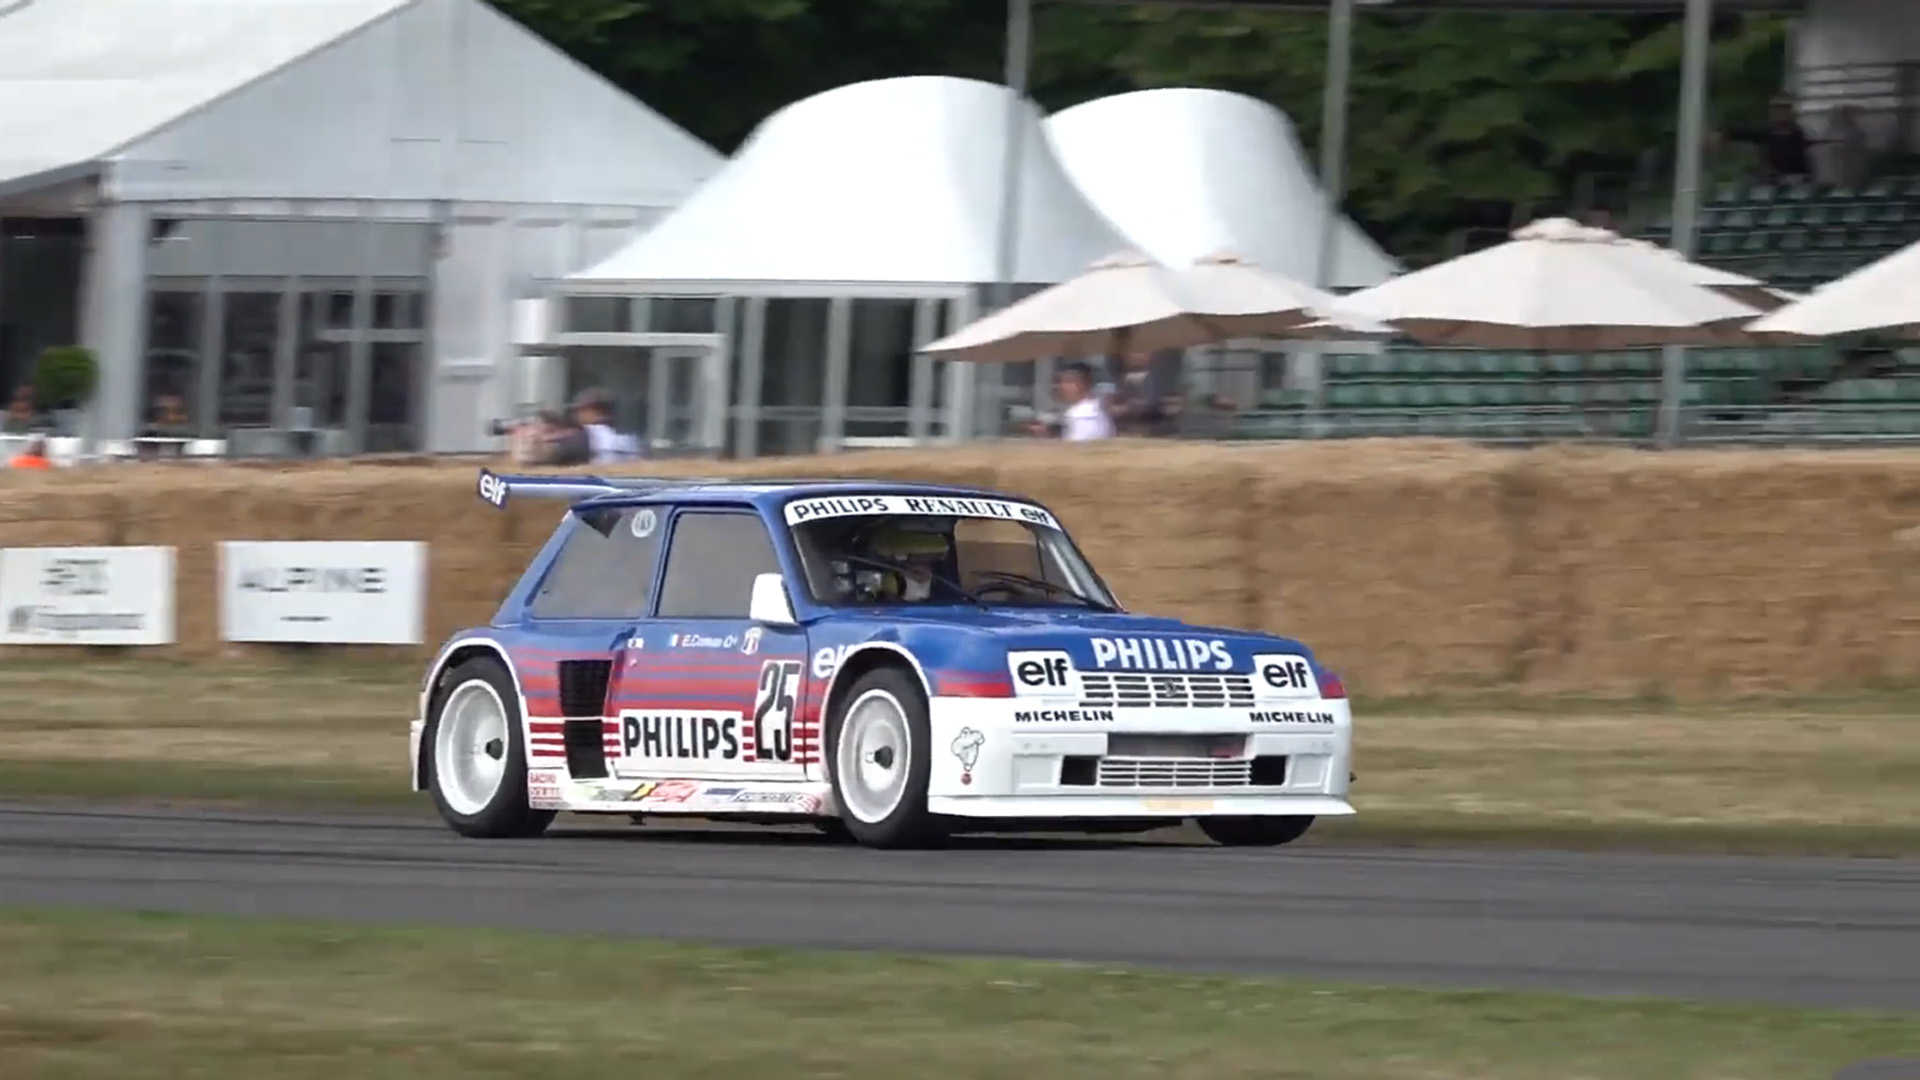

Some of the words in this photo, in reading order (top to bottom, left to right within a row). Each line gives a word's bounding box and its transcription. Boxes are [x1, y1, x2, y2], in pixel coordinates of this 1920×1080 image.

[480, 474, 507, 505] elf
[793, 497, 888, 519] PHILIPS
[904, 498, 1012, 517] RENAULT
[1020, 507, 1050, 525] elf
[1090, 637, 1234, 671] PHILIPS
[1017, 657, 1069, 686] elf
[1262, 661, 1307, 688] elf
[754, 661, 801, 761] 25
[1014, 709, 1115, 723] MICHELIN
[1248, 711, 1335, 724] MICHELIN
[623, 716, 739, 760] PHILIPS
